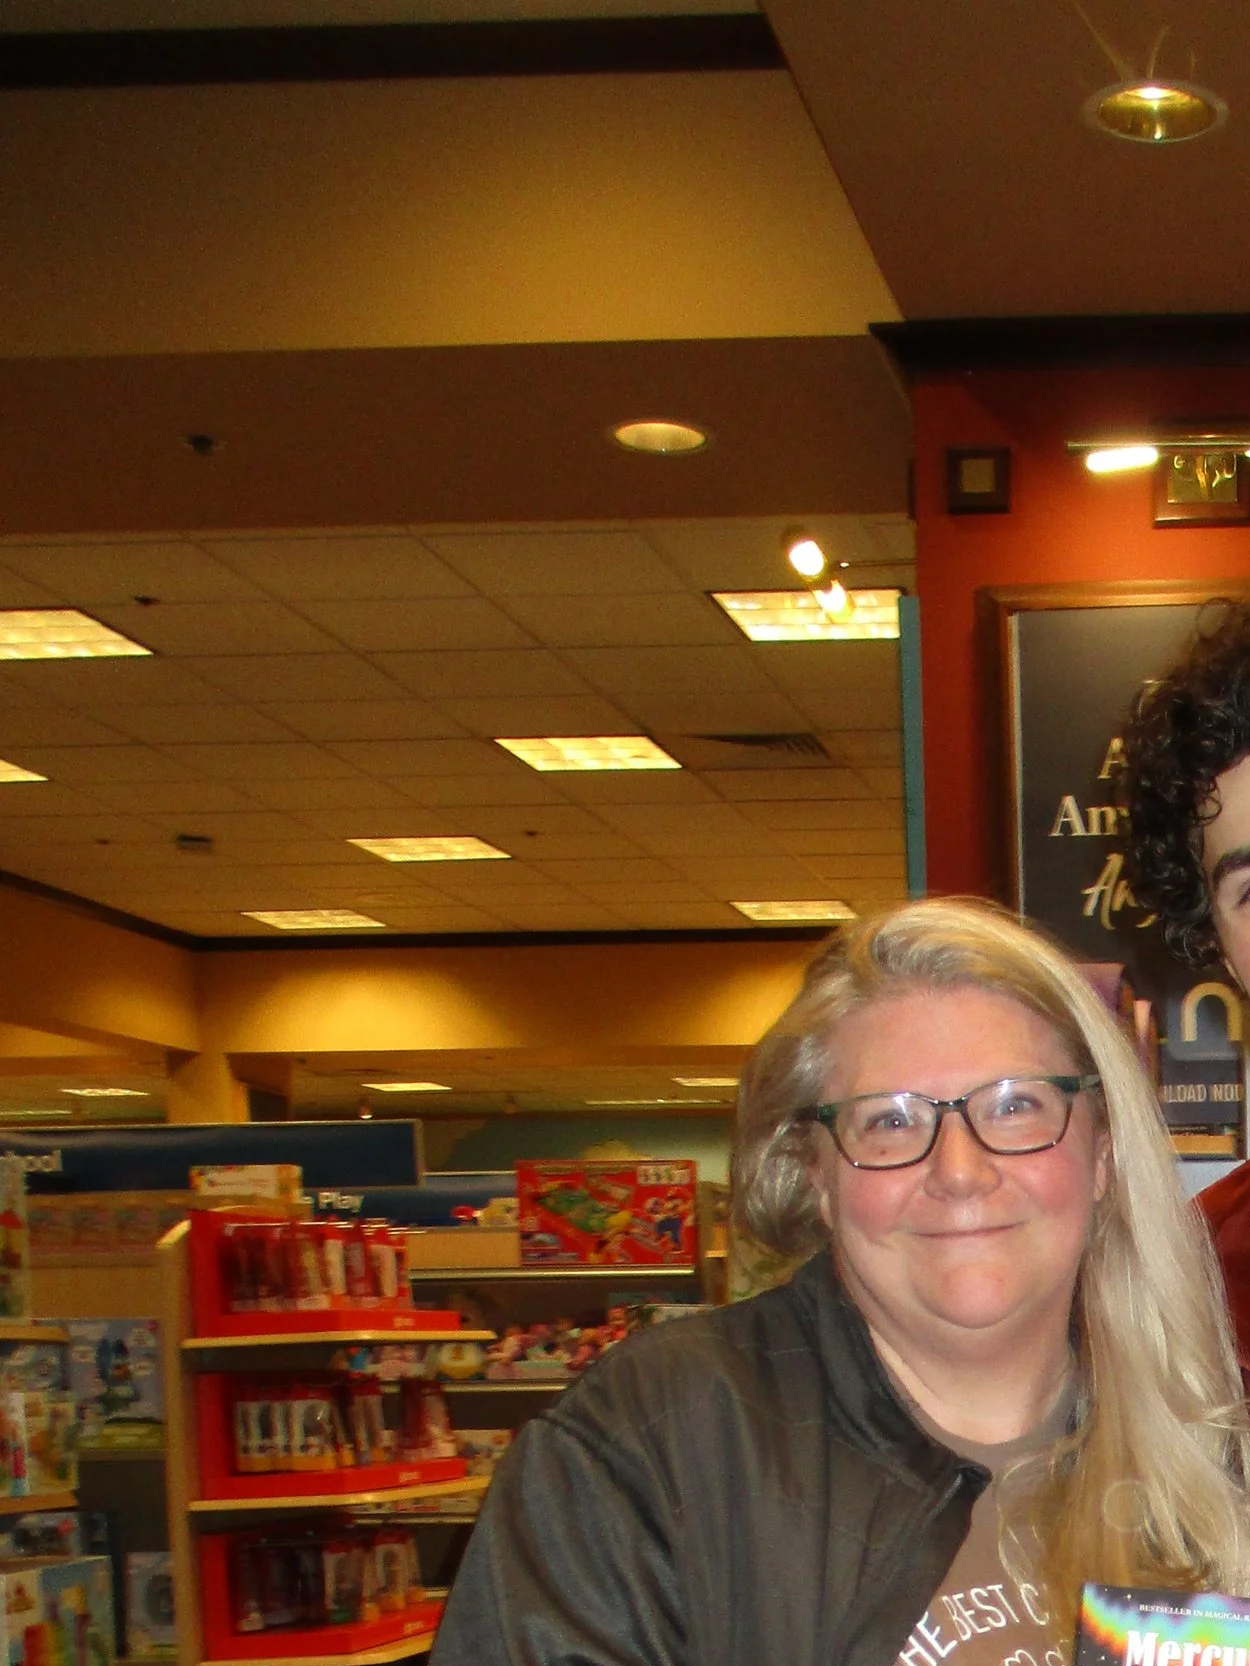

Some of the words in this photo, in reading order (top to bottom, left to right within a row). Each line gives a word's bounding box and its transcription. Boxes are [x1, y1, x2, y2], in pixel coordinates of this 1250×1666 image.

[941, 1584, 1020, 1642] BEST
[1139, 1604, 1193, 1617] BESTSELLER
[1204, 1611, 1243, 1622] MAGICAL
